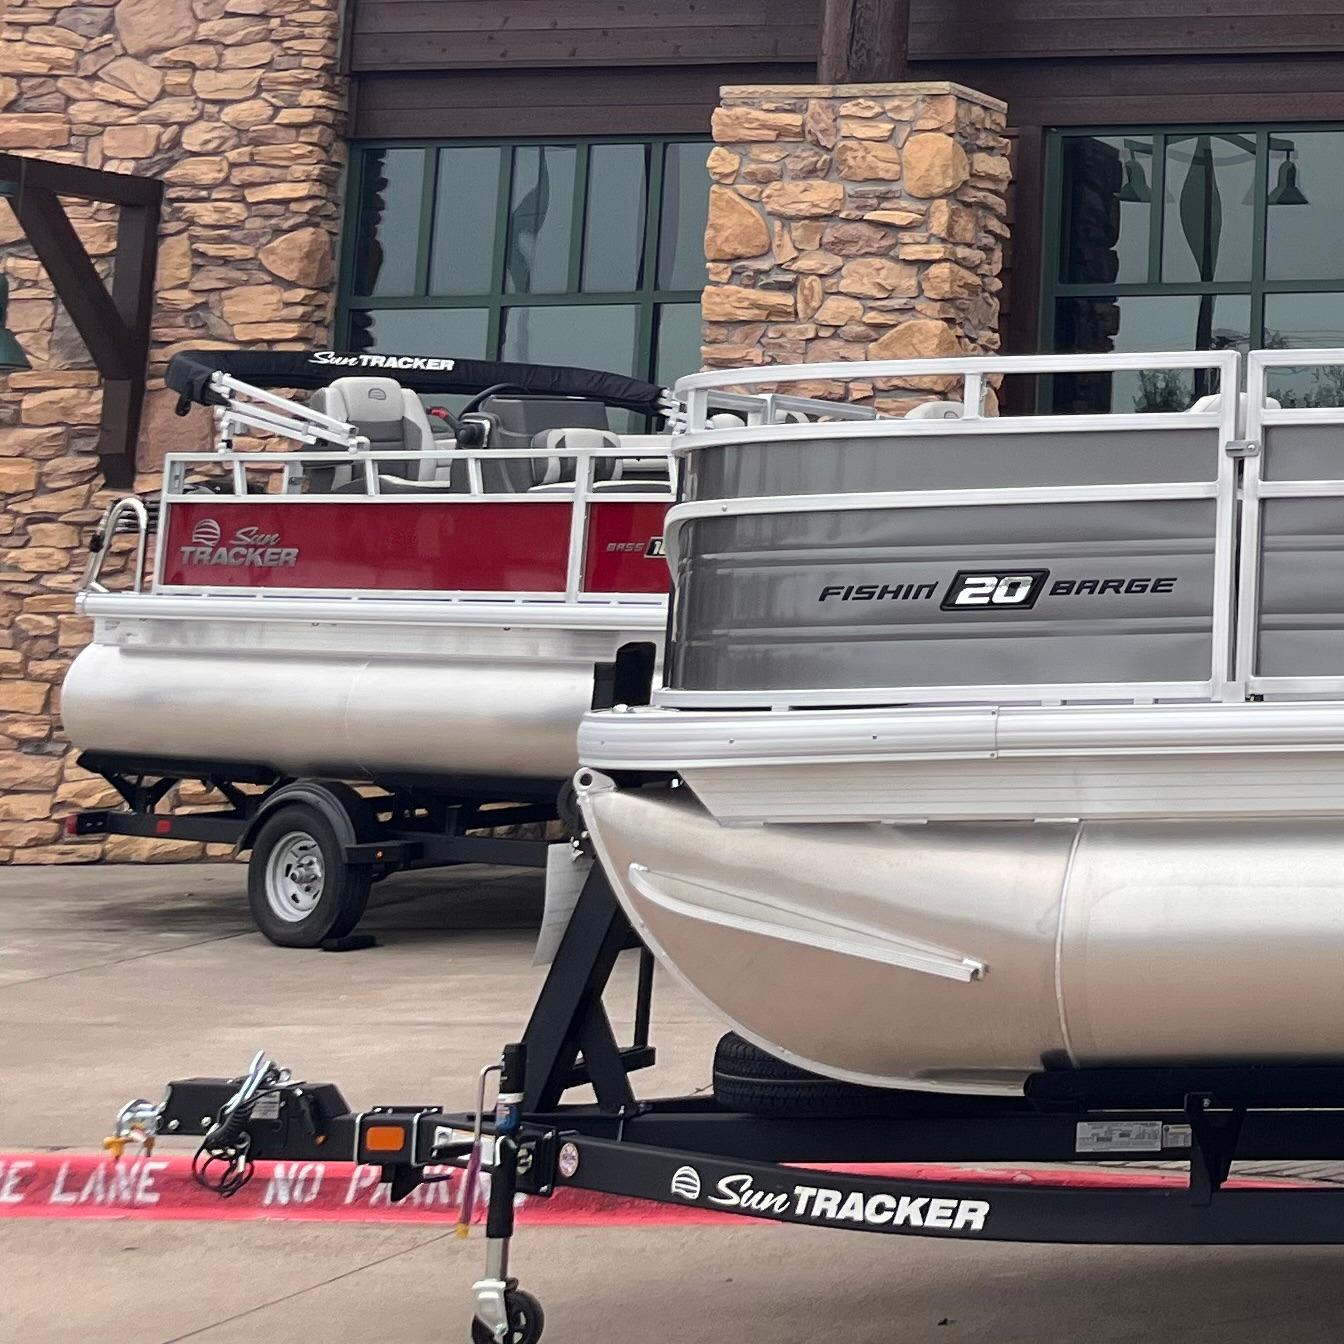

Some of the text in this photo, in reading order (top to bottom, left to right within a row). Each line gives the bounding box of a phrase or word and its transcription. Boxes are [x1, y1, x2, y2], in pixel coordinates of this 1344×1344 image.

[308, 351, 455, 371] Sun TRACKER
[229, 526, 281, 545] Sun
[181, 546, 298, 567] TRACKER
[607, 542, 645, 552] BASS
[955, 576, 1034, 605] 20
[1049, 577, 1178, 597] BARGE
[50, 1160, 169, 1204] LANE
[264, 1163, 326, 1206] NO
[708, 1174, 990, 1231] Sun TRACKER
